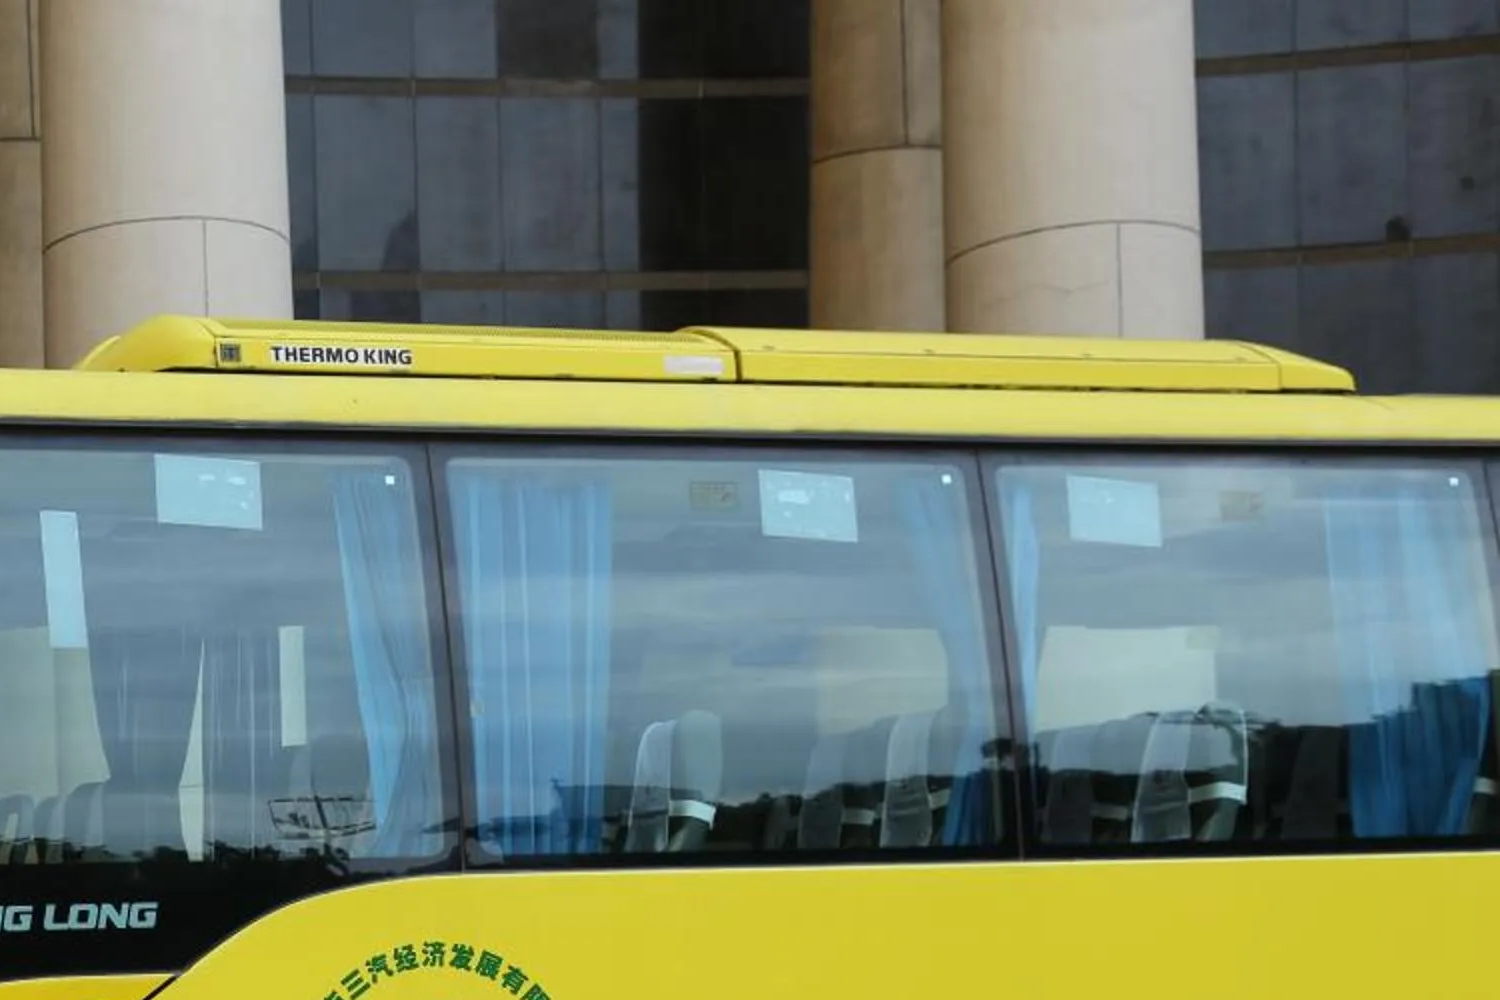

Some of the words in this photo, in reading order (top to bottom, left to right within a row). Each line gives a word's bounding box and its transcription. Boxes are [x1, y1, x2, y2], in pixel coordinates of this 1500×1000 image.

[271, 346, 358, 363] THERMO
[365, 348, 412, 365] KING
[42, 901, 159, 930] LONG
